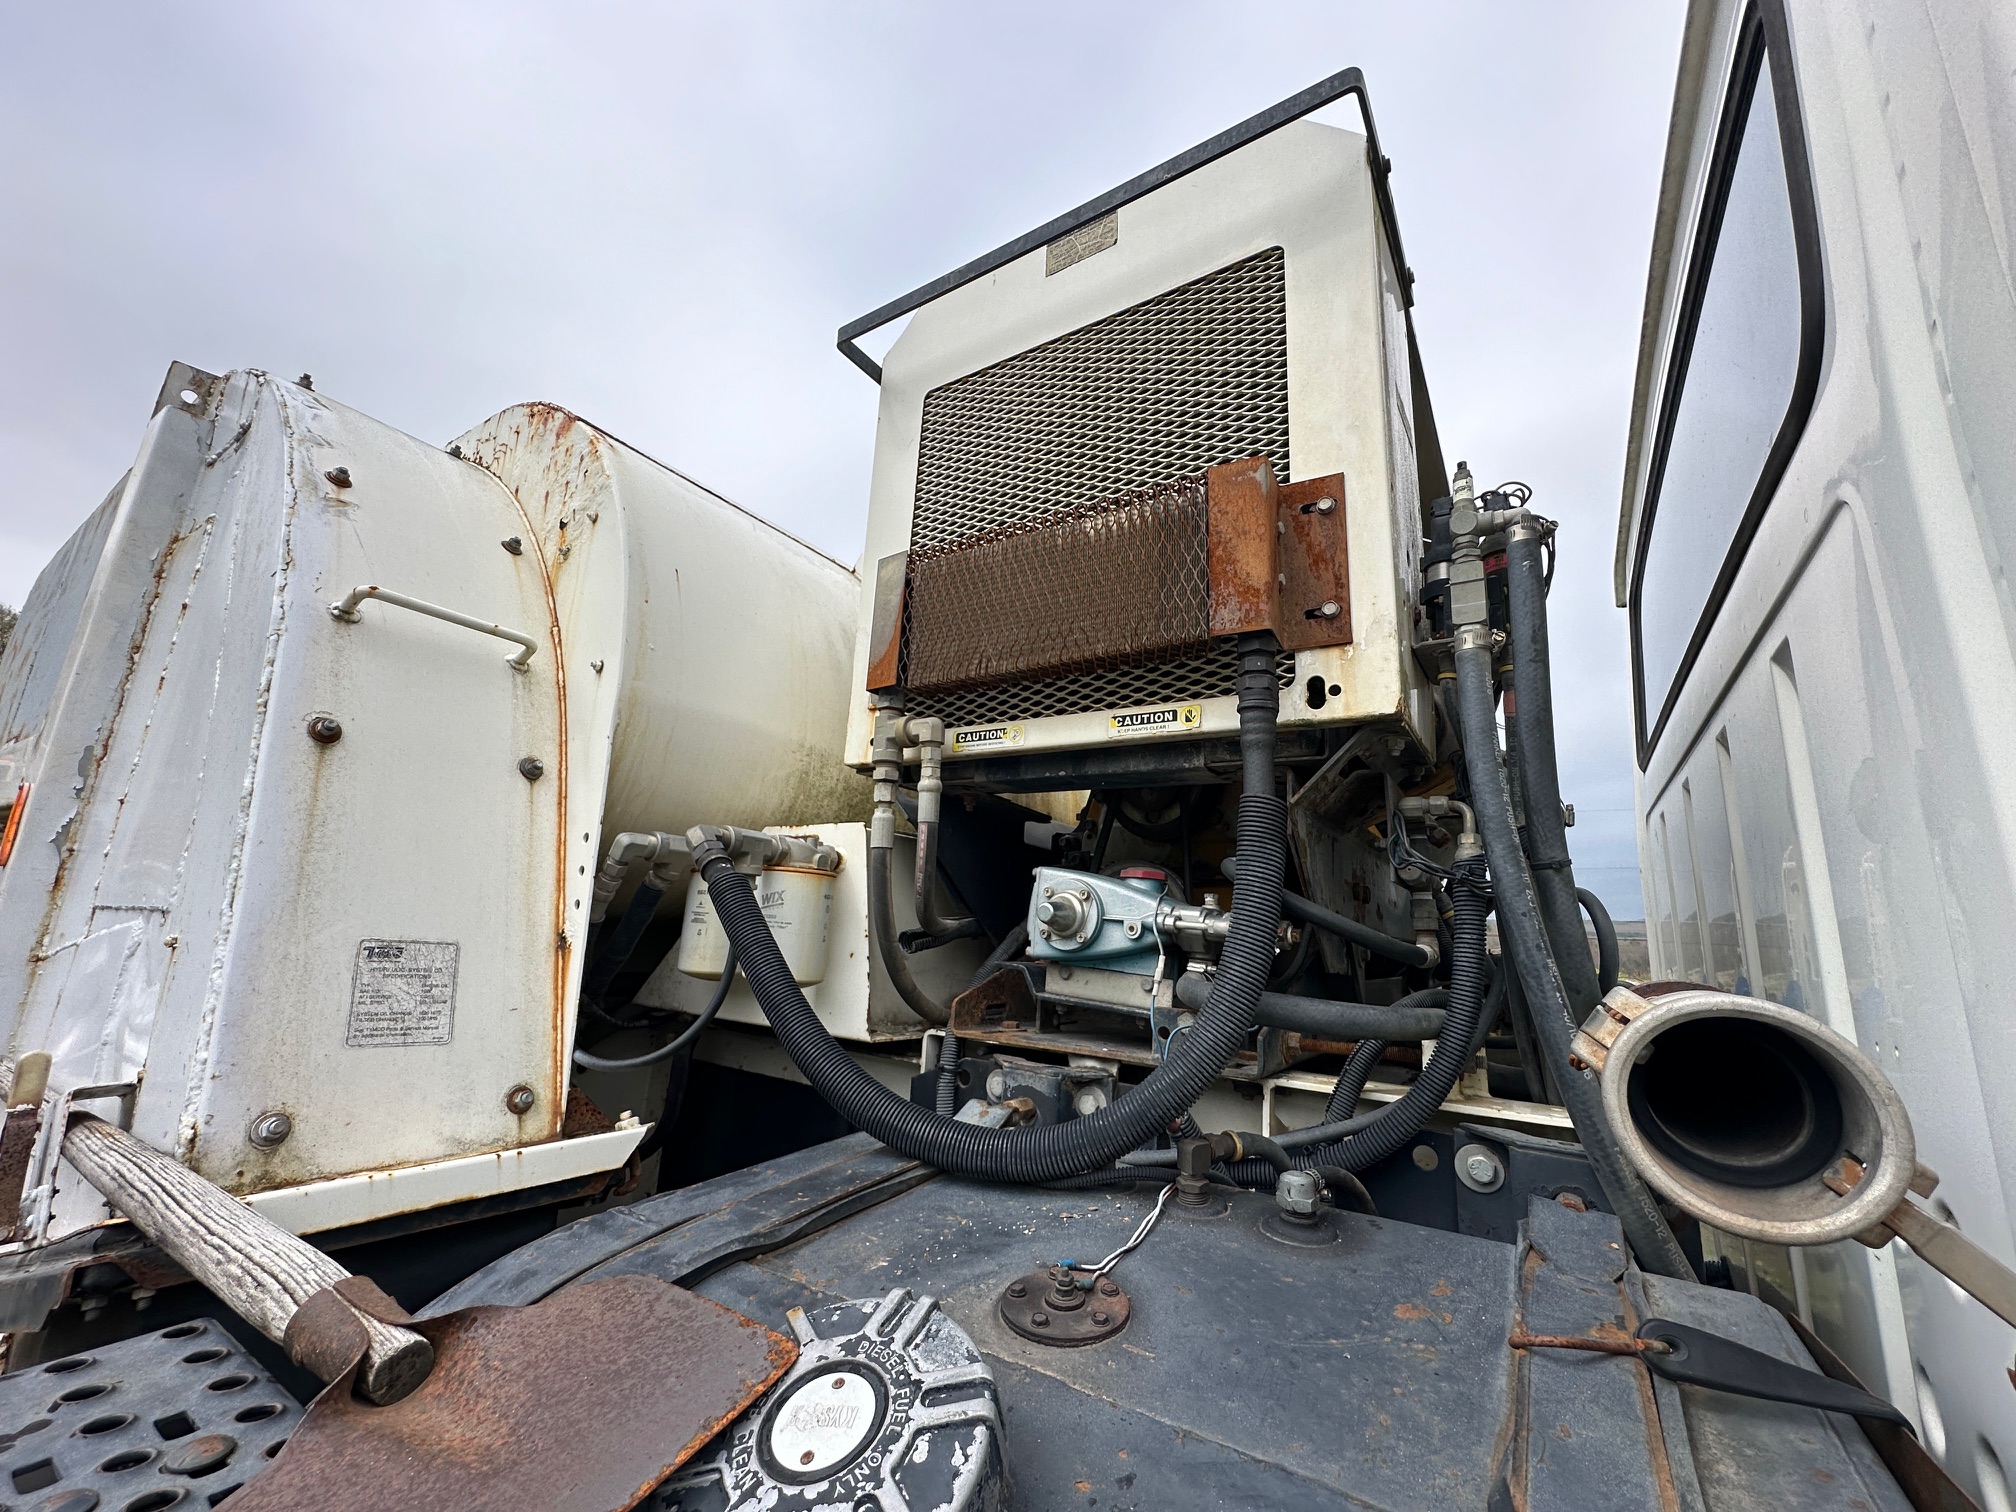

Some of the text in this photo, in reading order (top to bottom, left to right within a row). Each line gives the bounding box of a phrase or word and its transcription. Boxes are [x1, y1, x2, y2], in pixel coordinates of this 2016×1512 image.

[1116, 711, 1173, 727] CAUTION
[958, 729, 1004, 742] CAUTION
[761, 890, 787, 906] WIX
[1639, 1192, 1668, 1240] 7520-12
[834, 1340, 910, 1498] DIESEL FUEL ONLY
[731, 1431, 757, 1492] CLEAN
